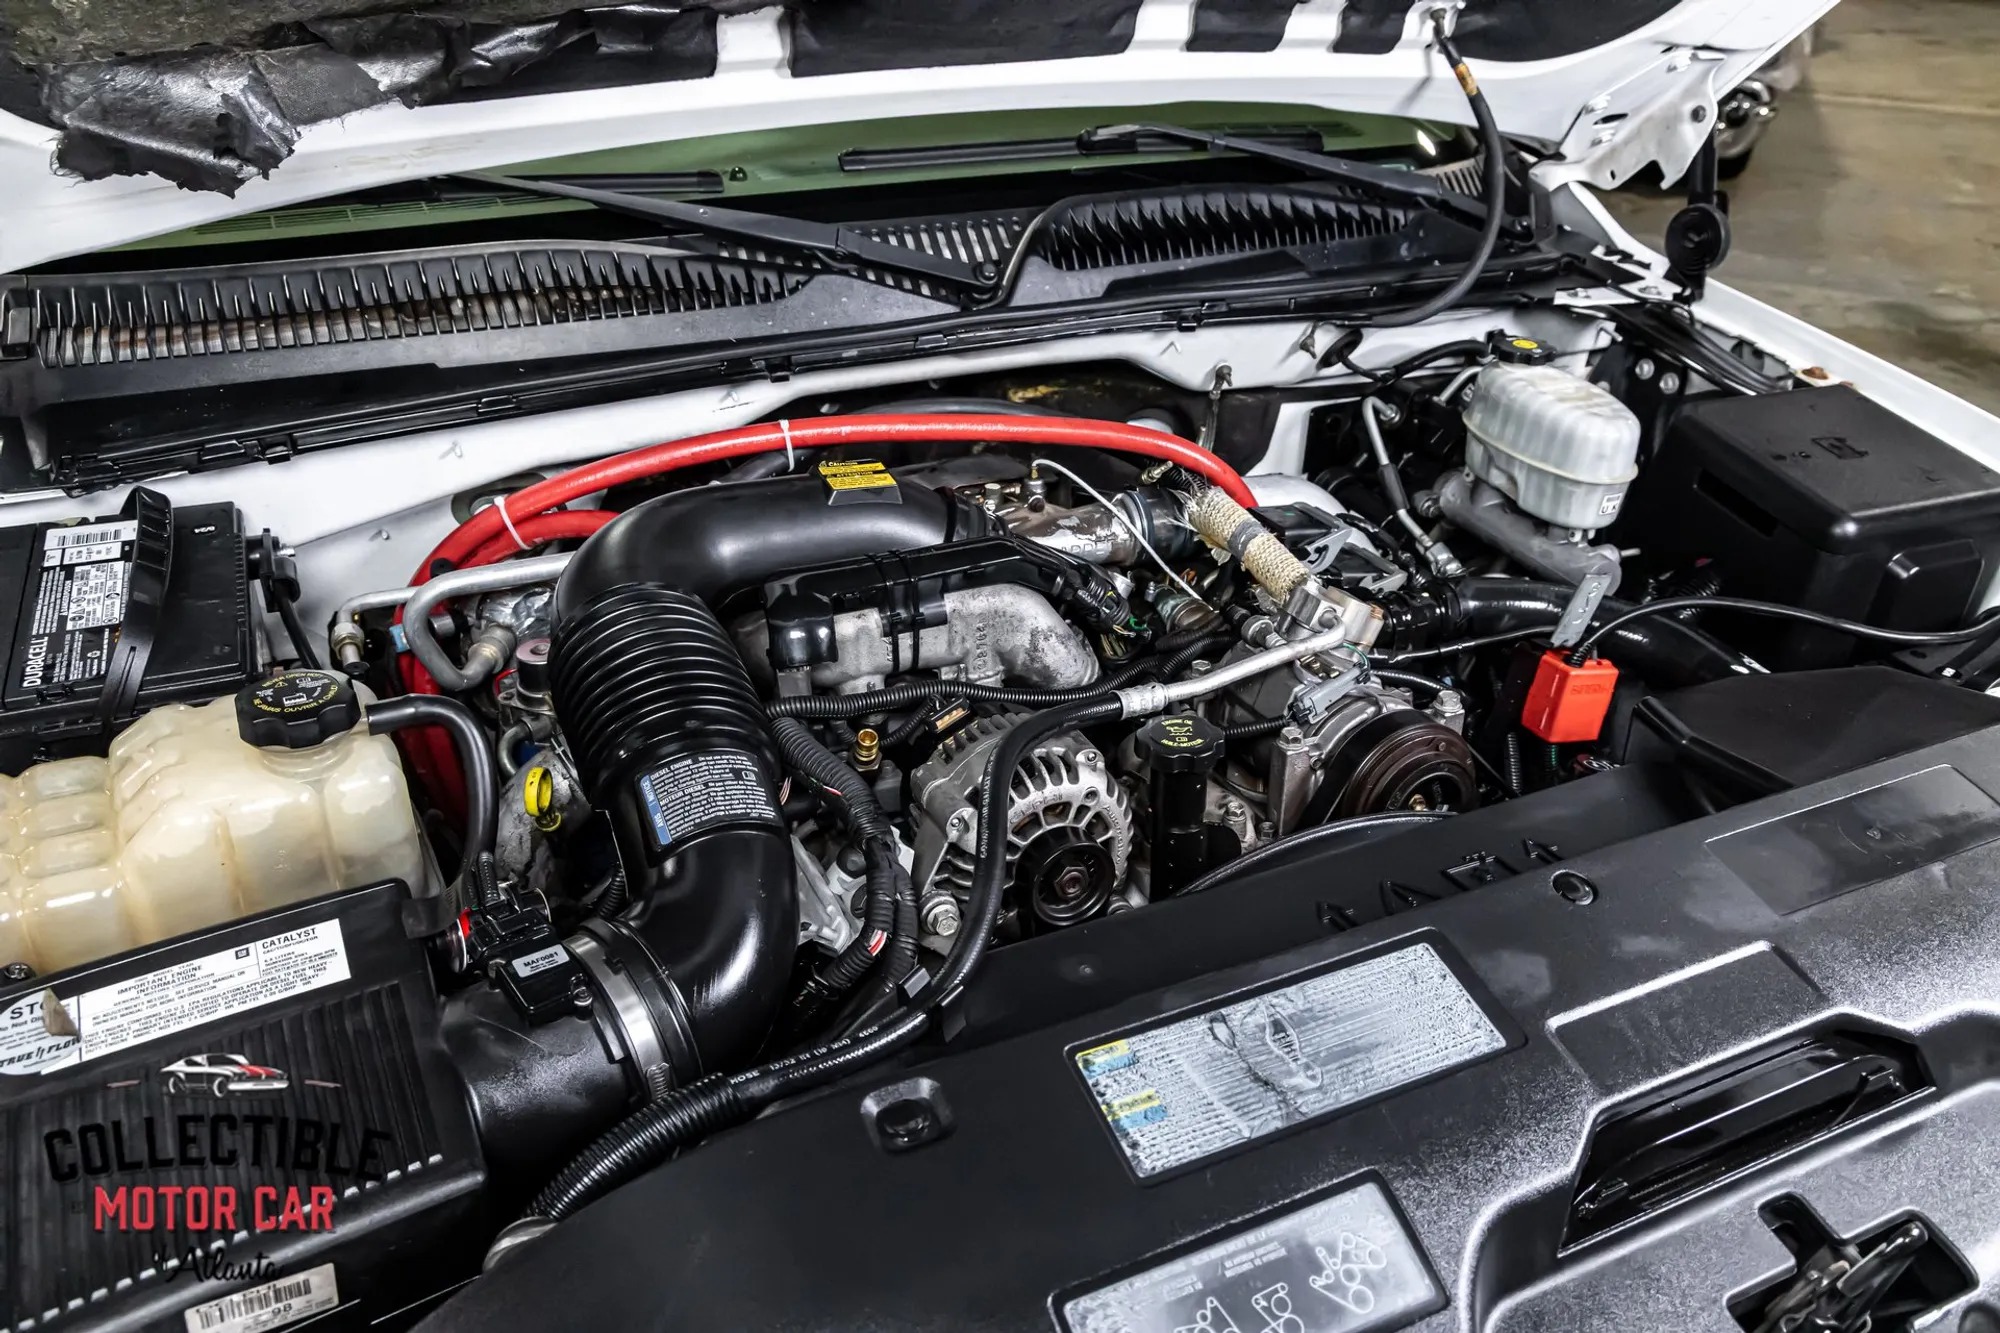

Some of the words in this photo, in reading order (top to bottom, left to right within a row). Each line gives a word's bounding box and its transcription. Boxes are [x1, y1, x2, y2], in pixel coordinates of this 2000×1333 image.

[22, 637, 48, 688] DURACELL
[284, 702, 318, 713] OUVRIR
[650, 767, 670, 780] DIESEL
[670, 758, 693, 771] ENGINE
[659, 791, 684, 806] MOTEUR
[684, 784, 707, 795] DIESEL
[261, 927, 317, 950] CATALYST
[116, 975, 167, 995] IMPORTANT
[171, 965, 203, 978] ENGINE
[135, 972, 196, 995] INFORMATION
[186, 981, 210, 991] SERVICE
[212, 973, 236, 984] MANUAL
[119, 1007, 143, 1018] MANUAL
[158, 997, 175, 1006] MORE
[177, 985, 217, 1000] INFORMATION
[126, 1011, 162, 1026] CONFORMS
[201, 986, 244, 1002] REGULATIONS
[245, 974, 281, 989] APPLICABLE
[292, 967, 307, 975] NEW
[154, 1012, 178, 1022] ENGINE
[186, 999, 219, 1012] CERTIFIED
[230, 987, 258, 999] OPERATE
[269, 977, 290, 987] DIESEL
[312, 966, 327, 974] THIS
[10, 1001, 45, 1020] ST
[131, 1022, 161, 1034] PRIMARY
[162, 1011, 195, 1025] INTENDED
[196, 1003, 221, 1014] SERVICE
[223, 990, 263, 1006] APPLICATION
[279, 979, 298, 989] LIGHT
[730, 1069, 760, 1085] HOSE
